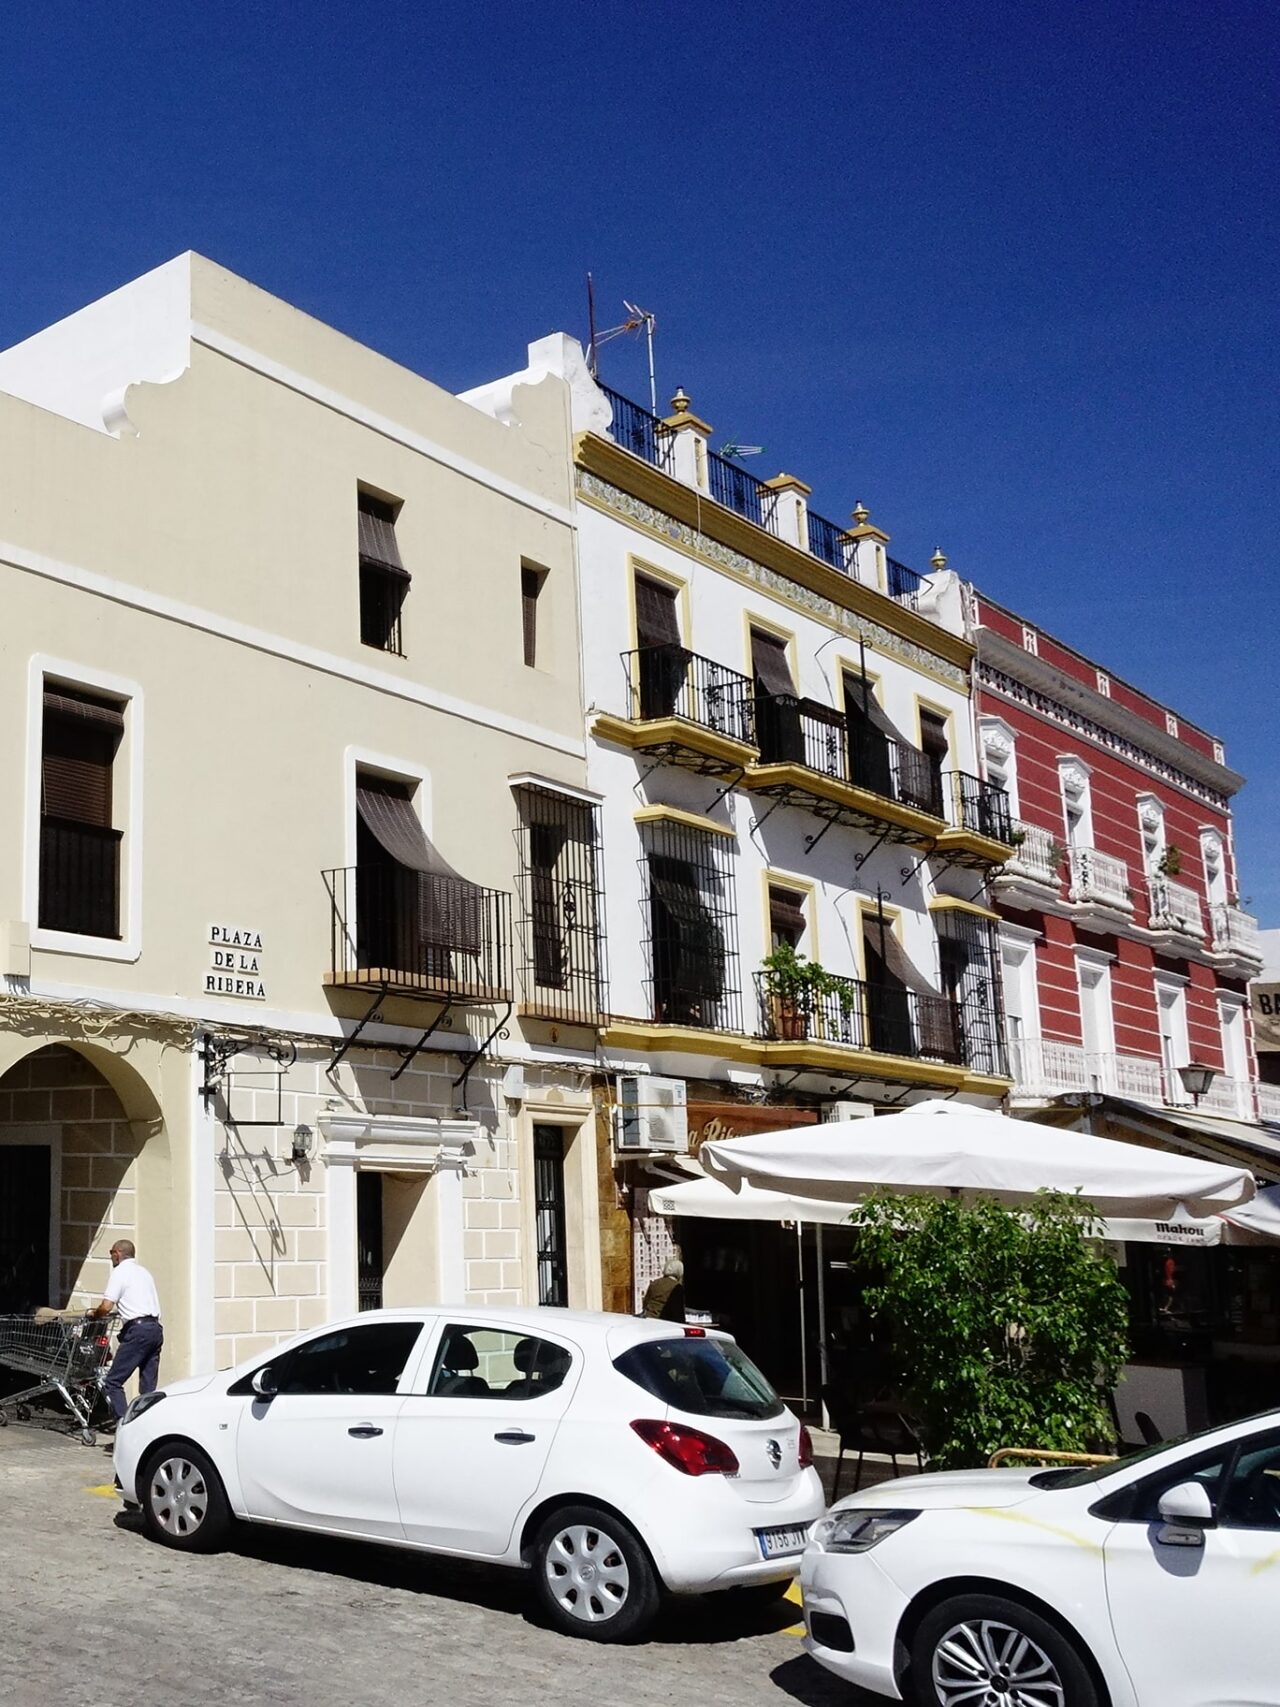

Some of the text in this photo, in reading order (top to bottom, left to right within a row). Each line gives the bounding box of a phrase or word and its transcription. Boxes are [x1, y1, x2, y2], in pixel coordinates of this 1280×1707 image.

[211, 926, 262, 947] PLAZA
[215, 952, 258, 971] DE LA
[206, 976, 265, 996] RIBERA
[1155, 1223, 1204, 1236] Mahou
